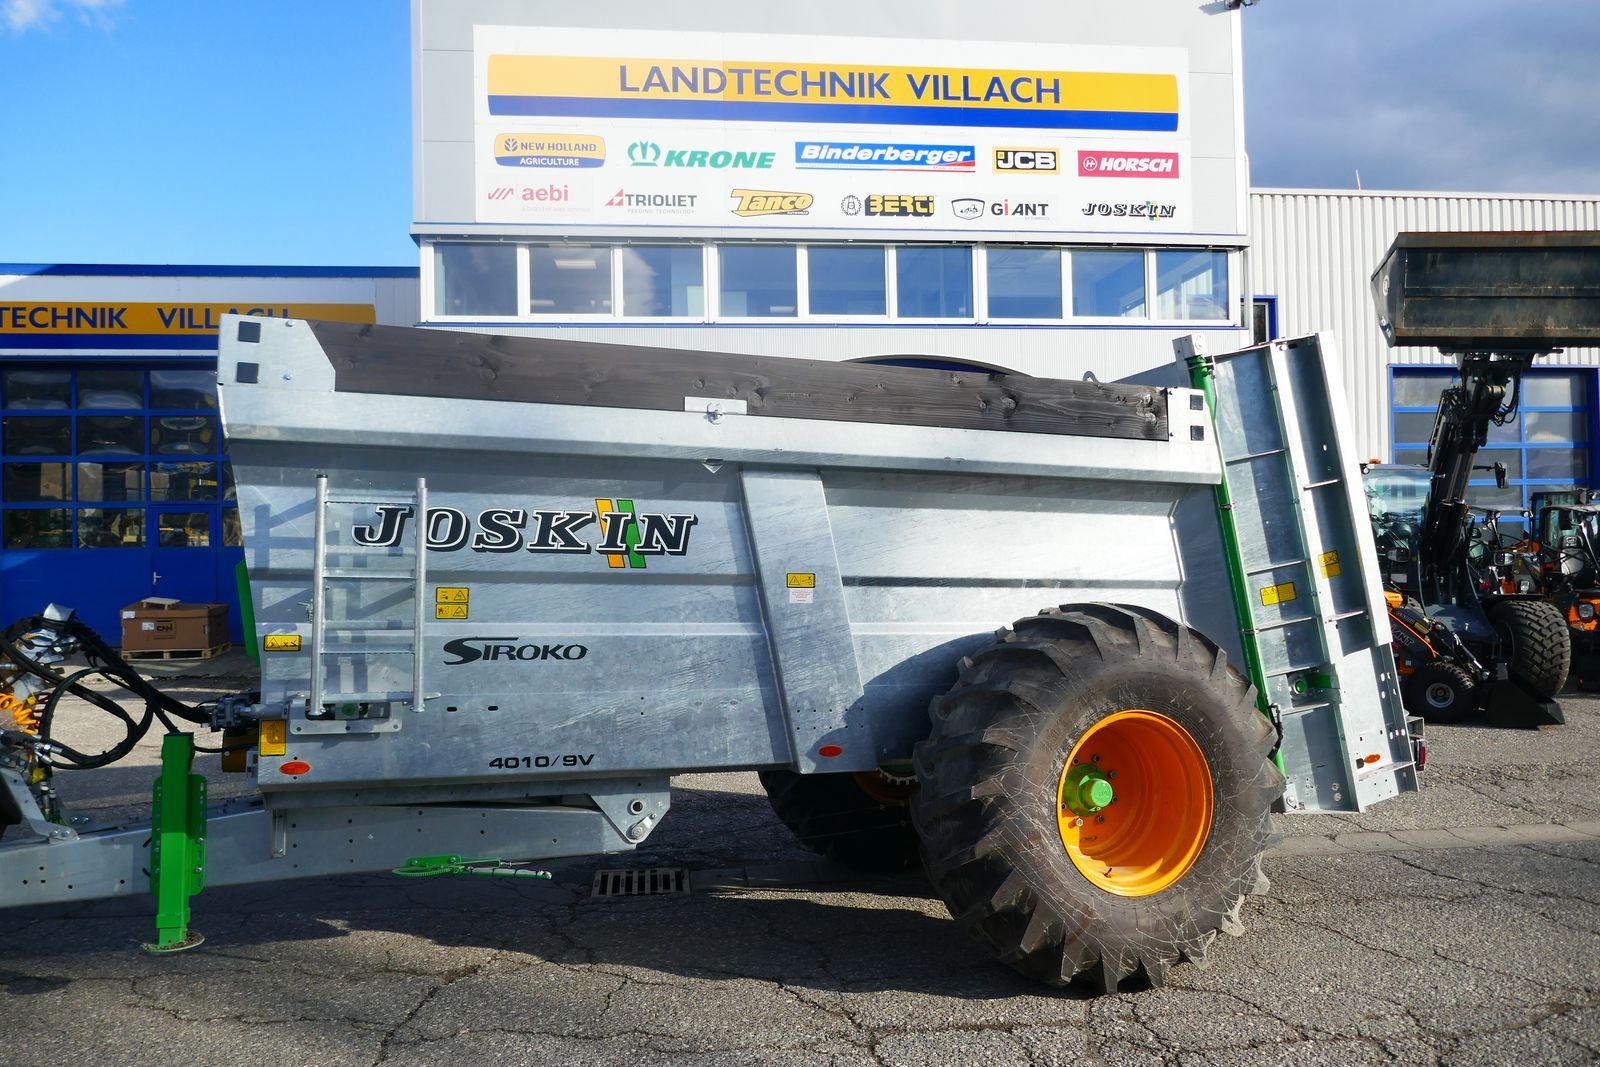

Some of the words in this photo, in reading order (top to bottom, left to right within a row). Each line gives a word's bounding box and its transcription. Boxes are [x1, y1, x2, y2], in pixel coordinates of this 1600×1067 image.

[620, 65, 891, 98] LANDTECHNIK
[906, 73, 1060, 104] VILLACH
[520, 143, 544, 151] NEW
[547, 143, 597, 152] HOLLAND
[800, 144, 971, 164] Binderberger
[519, 157, 580, 166] AGRICULTURE
[664, 150, 776, 169] KRONE
[996, 151, 1056, 169] JCB
[1100, 157, 1174, 173] HORSCH
[521, 185, 569, 202] aebi
[625, 193, 697, 207] TRIOLIET
[731, 189, 812, 212] Tanco
[1081, 202, 1177, 219] JOSKIN
[157, 307, 289, 329] VILL
[352, 505, 698, 556] JOSKIN
[488, 753, 595, 770] 4010/9V
